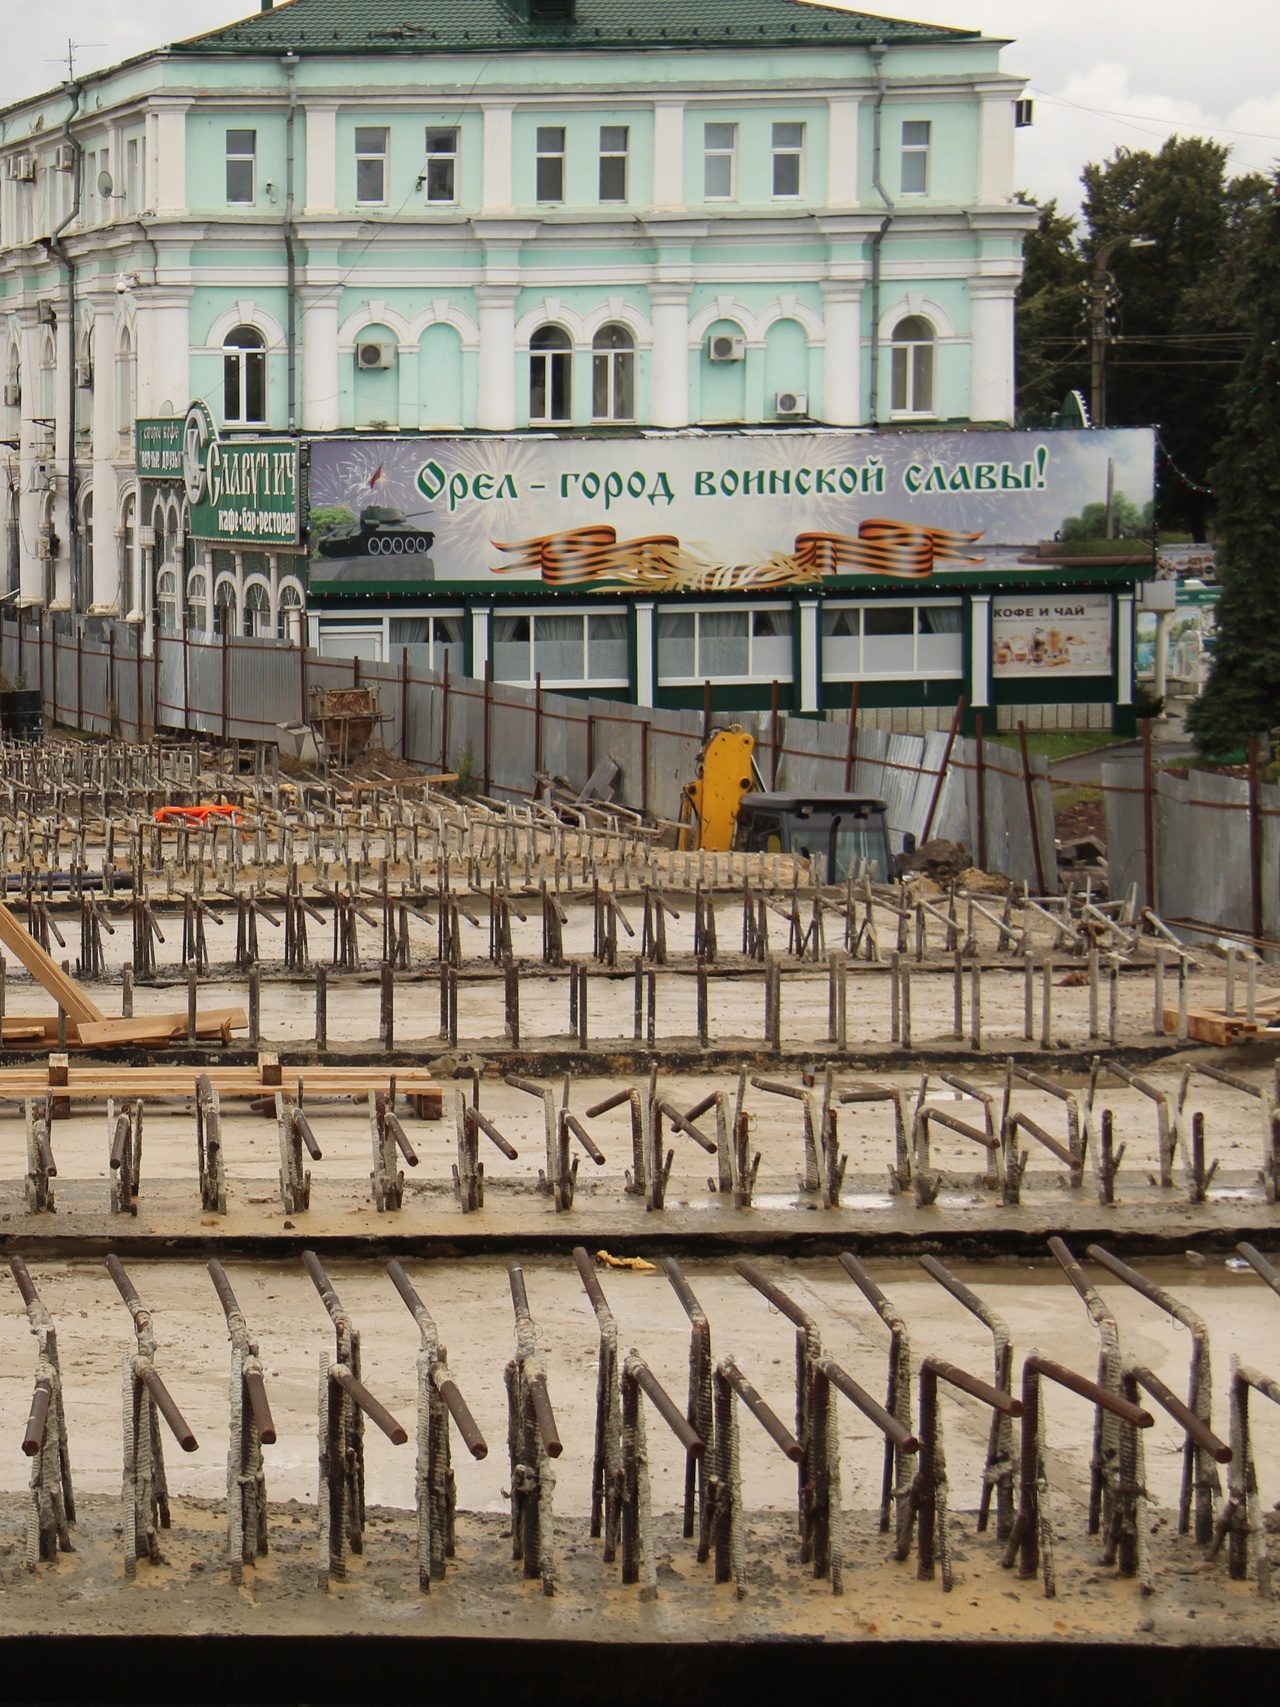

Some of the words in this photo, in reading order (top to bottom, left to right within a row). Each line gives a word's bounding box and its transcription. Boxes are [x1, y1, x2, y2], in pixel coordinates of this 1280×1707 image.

[417, 459, 518, 511] Орел
[561, 471, 674, 509] город
[695, 458, 885, 496] воинской
[904, 446, 1047, 493] славы!
[993, 608, 1034, 618] КОФЕ
[1039, 608, 1049, 616] И
[1054, 605, 1084, 616] ЧАЙ
